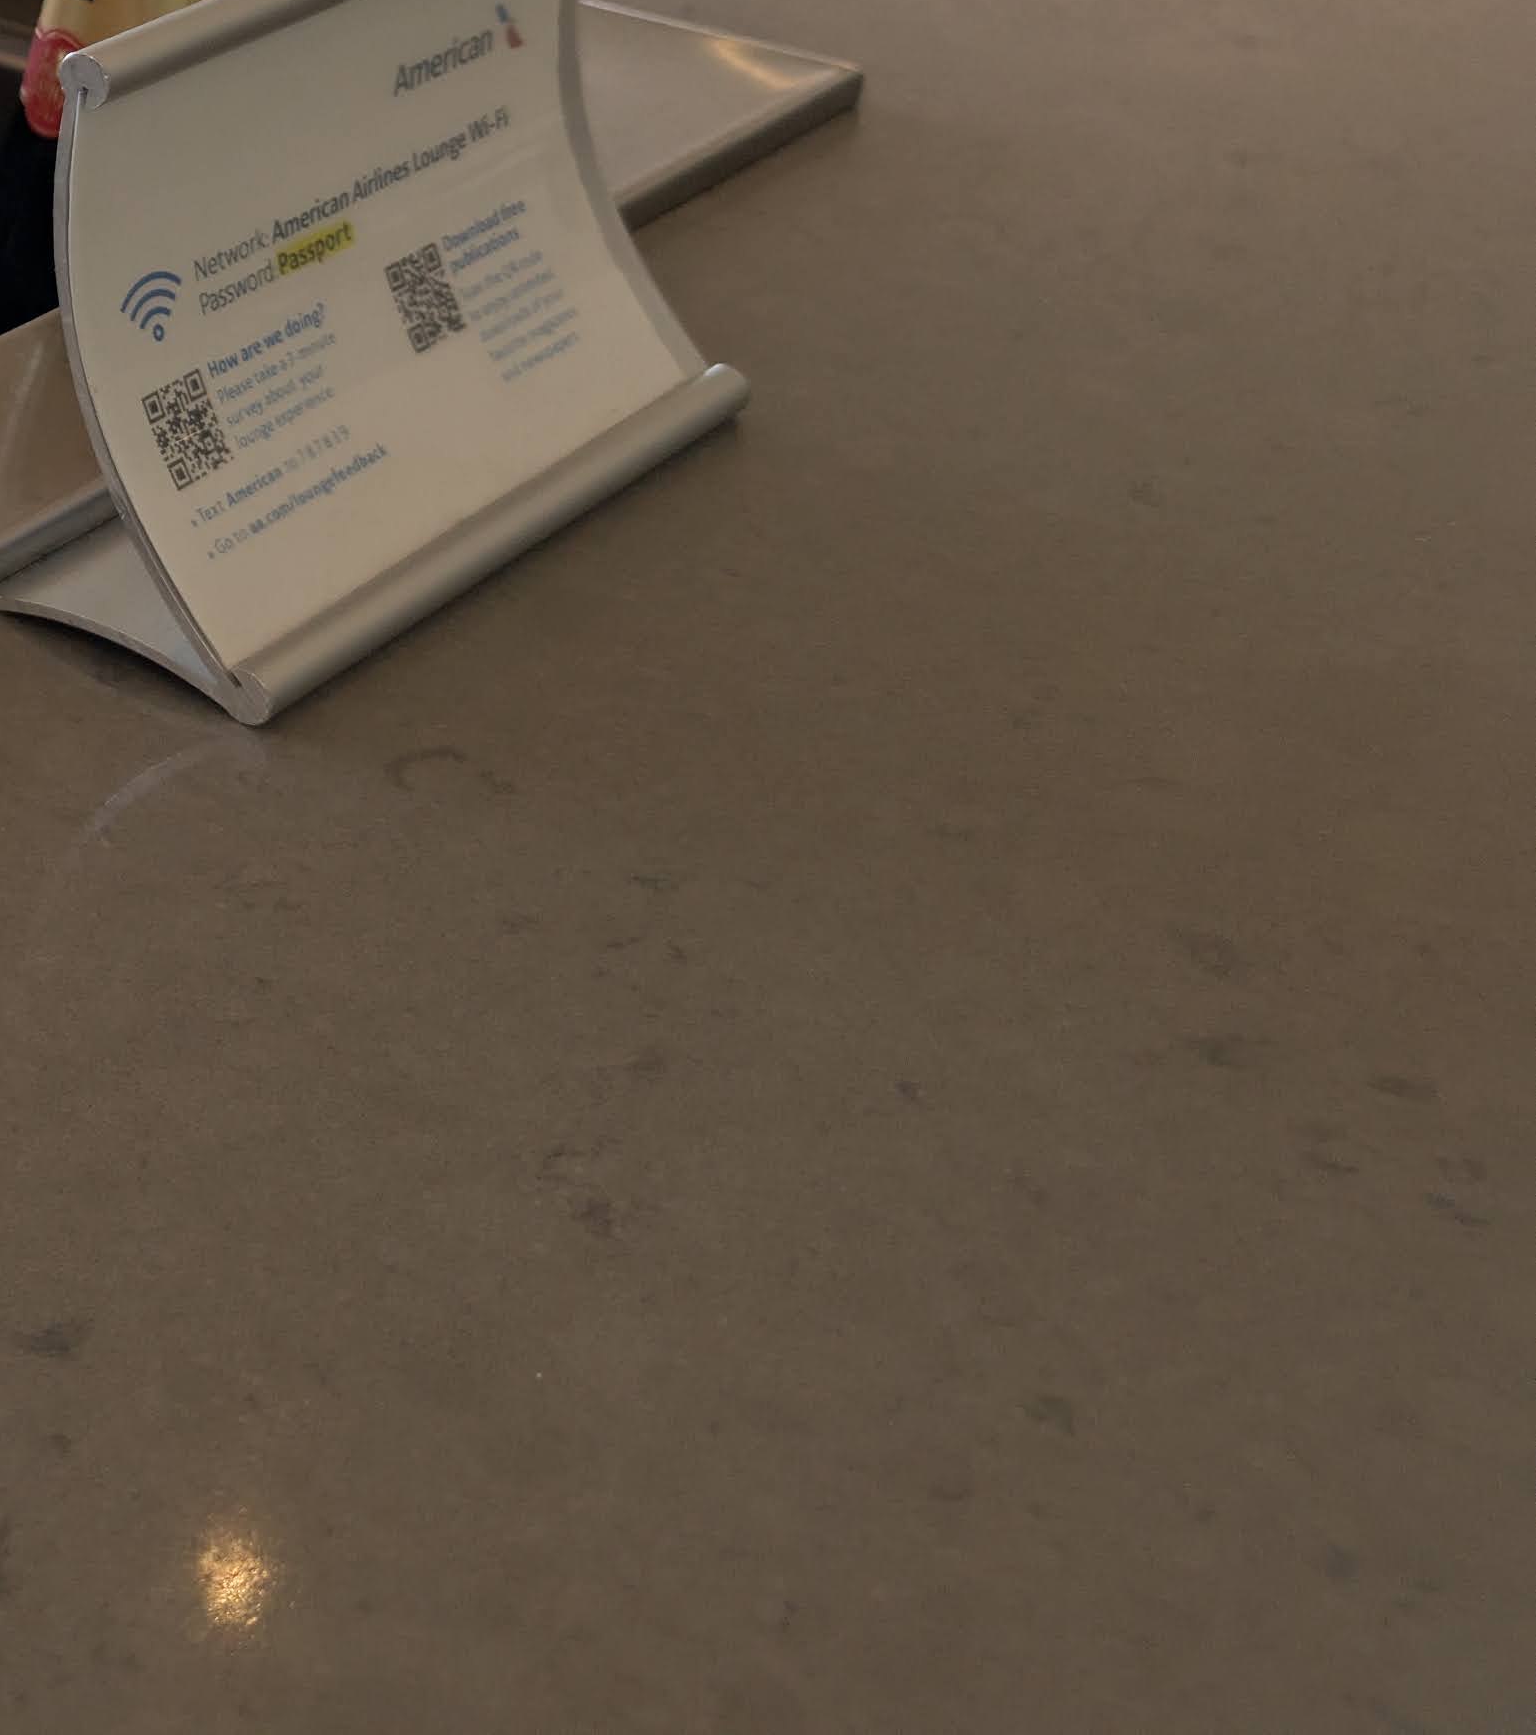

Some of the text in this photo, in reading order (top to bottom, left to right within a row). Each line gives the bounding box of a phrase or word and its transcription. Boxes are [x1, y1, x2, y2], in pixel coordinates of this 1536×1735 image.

[392, 28, 493, 97] American
[272, 188, 351, 244] American
[352, 157, 411, 203] Airlines
[412, 131, 467, 174] Lounge
[468, 105, 510, 144] Wi-Fi
[277, 221, 352, 275] Passport
[207, 302, 326, 379] How are we doing?
[216, 377, 254, 404] Please
[196, 500, 226, 524] Text
[226, 465, 284, 507] American
[213, 536, 235, 555] Go
